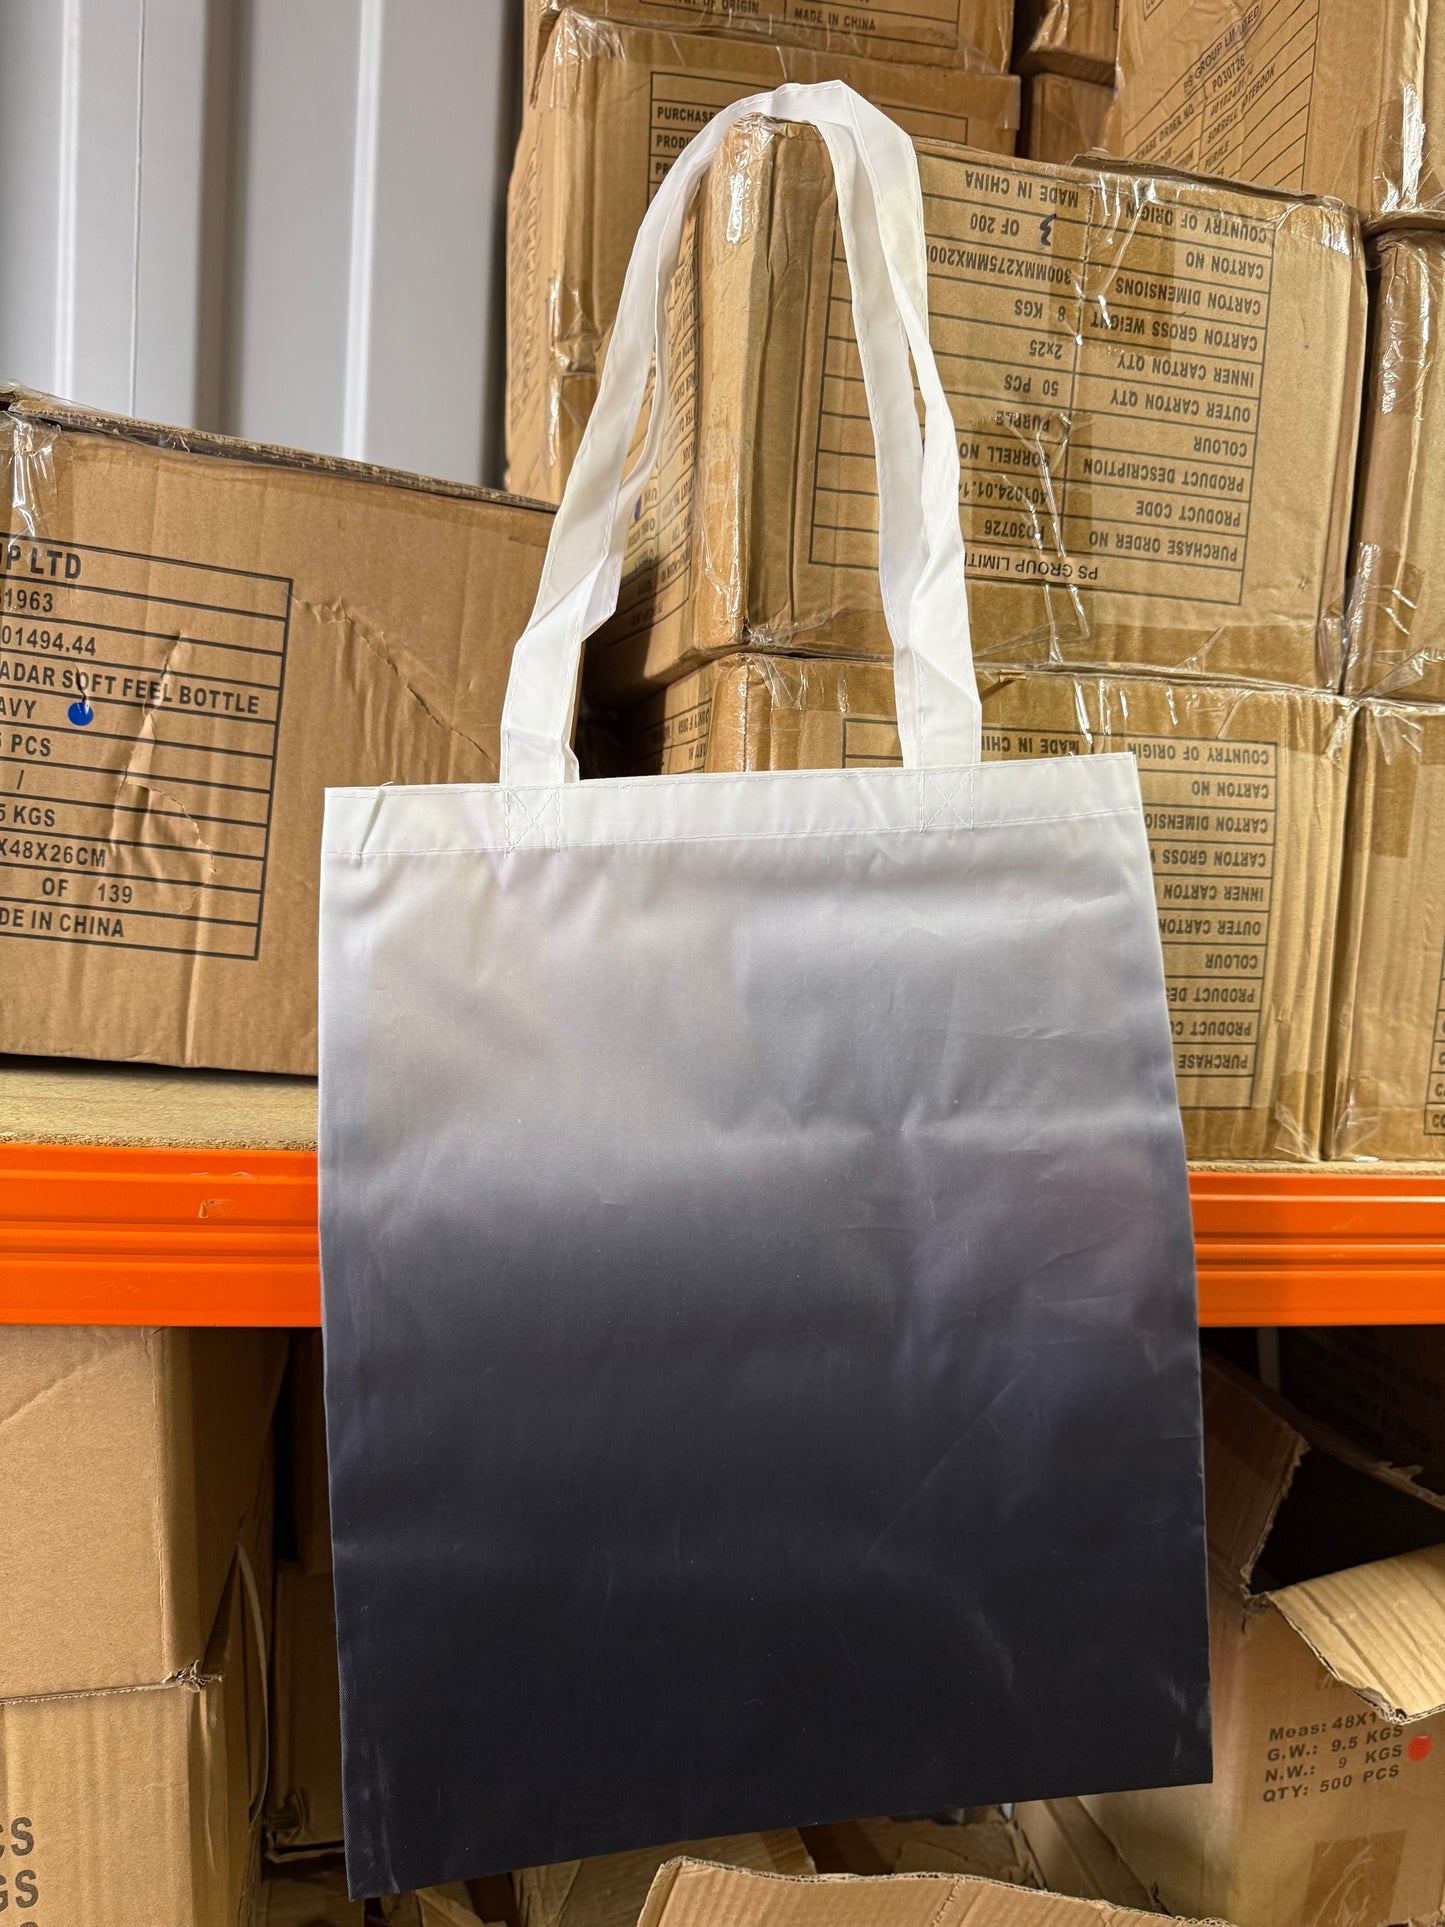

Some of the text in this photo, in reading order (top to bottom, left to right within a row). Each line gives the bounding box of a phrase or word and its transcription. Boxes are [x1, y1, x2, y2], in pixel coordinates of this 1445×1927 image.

[795, 8, 876, 31] MADE IN CHINA
[1194, 42, 1223, 79] GROUP
[1211, 54, 1246, 93] PO30726
[964, 170, 1079, 209] MADE IN CHINA
[969, 212, 1020, 237] OF 200
[1180, 213, 1198, 231] OF
[1203, 217, 1267, 244] COUNTRY
[1185, 250, 1264, 280] CARTON NO
[1114, 277, 1261, 316] CARTON DIMENSIONS
[1013, 299, 1066, 324] 8 KGS
[1090, 311, 1258, 352] CARTON GROSS WEIGHT
[1028, 340, 1063, 361] 2x25
[1116, 353, 1255, 389] INNER CARTON QTY
[1003, 374, 1059, 397] 50 PCS
[1109, 388, 1251, 424] OUTER CARTON QTY
[995, 410, 1050, 433] PURPLE
[1193, 436, 1247, 458] COLOUR
[1083, 457, 1244, 493] PRODUCT DESCRIPTION
[1135, 500, 1241, 528] PRODUCT CODE
[1088, 531, 1238, 563] PURCHASE ORDER NO
[0, 543, 82, 580] P LTD
[964, 552, 1098, 580] PS GROUP LIMIT
[0, 587, 53, 613] 1963
[2, 625, 96, 656] 01494.44
[0, 661, 260, 715] ADAR SOFT FEEL BOTTLE
[11, 734, 51, 757] PCS
[1017, 737, 1033, 754] IN
[1040, 738, 1079, 757] MADE
[1183, 746, 1200, 762] OF
[1207, 747, 1269, 766] COUNTRY
[1191, 780, 1269, 800] CARTON NO
[13, 805, 56, 827] KGS
[1215, 816, 1268, 835] CARTON
[1162, 849, 1207, 866] GROSS
[1213, 850, 1266, 869] CARTON
[42, 877, 133, 904] OF 139
[1163, 884, 1264, 902] INNER CARTON
[31, 910, 52, 931] IN
[60, 914, 125, 938] CHINA
[1158, 918, 1261, 937] OUTER CARTON
[1205, 953, 1258, 971] COLOUR
[1192, 987, 1255, 1004] PRODUCT
[1189, 1020, 1252, 1037] PRODUCT
[1178, 1054, 1248, 1070] PURCHASE
[1267, 1724, 1404, 1762] G.W.: 9.5 KGS
[1269, 1723, 1327, 1741] Meas:
[1265, 1744, 1402, 1783] N.W.: 9 KGS
[1262, 1764, 1400, 1803] QTY: 500 PCS
[0, 1816, 35, 1857] S
